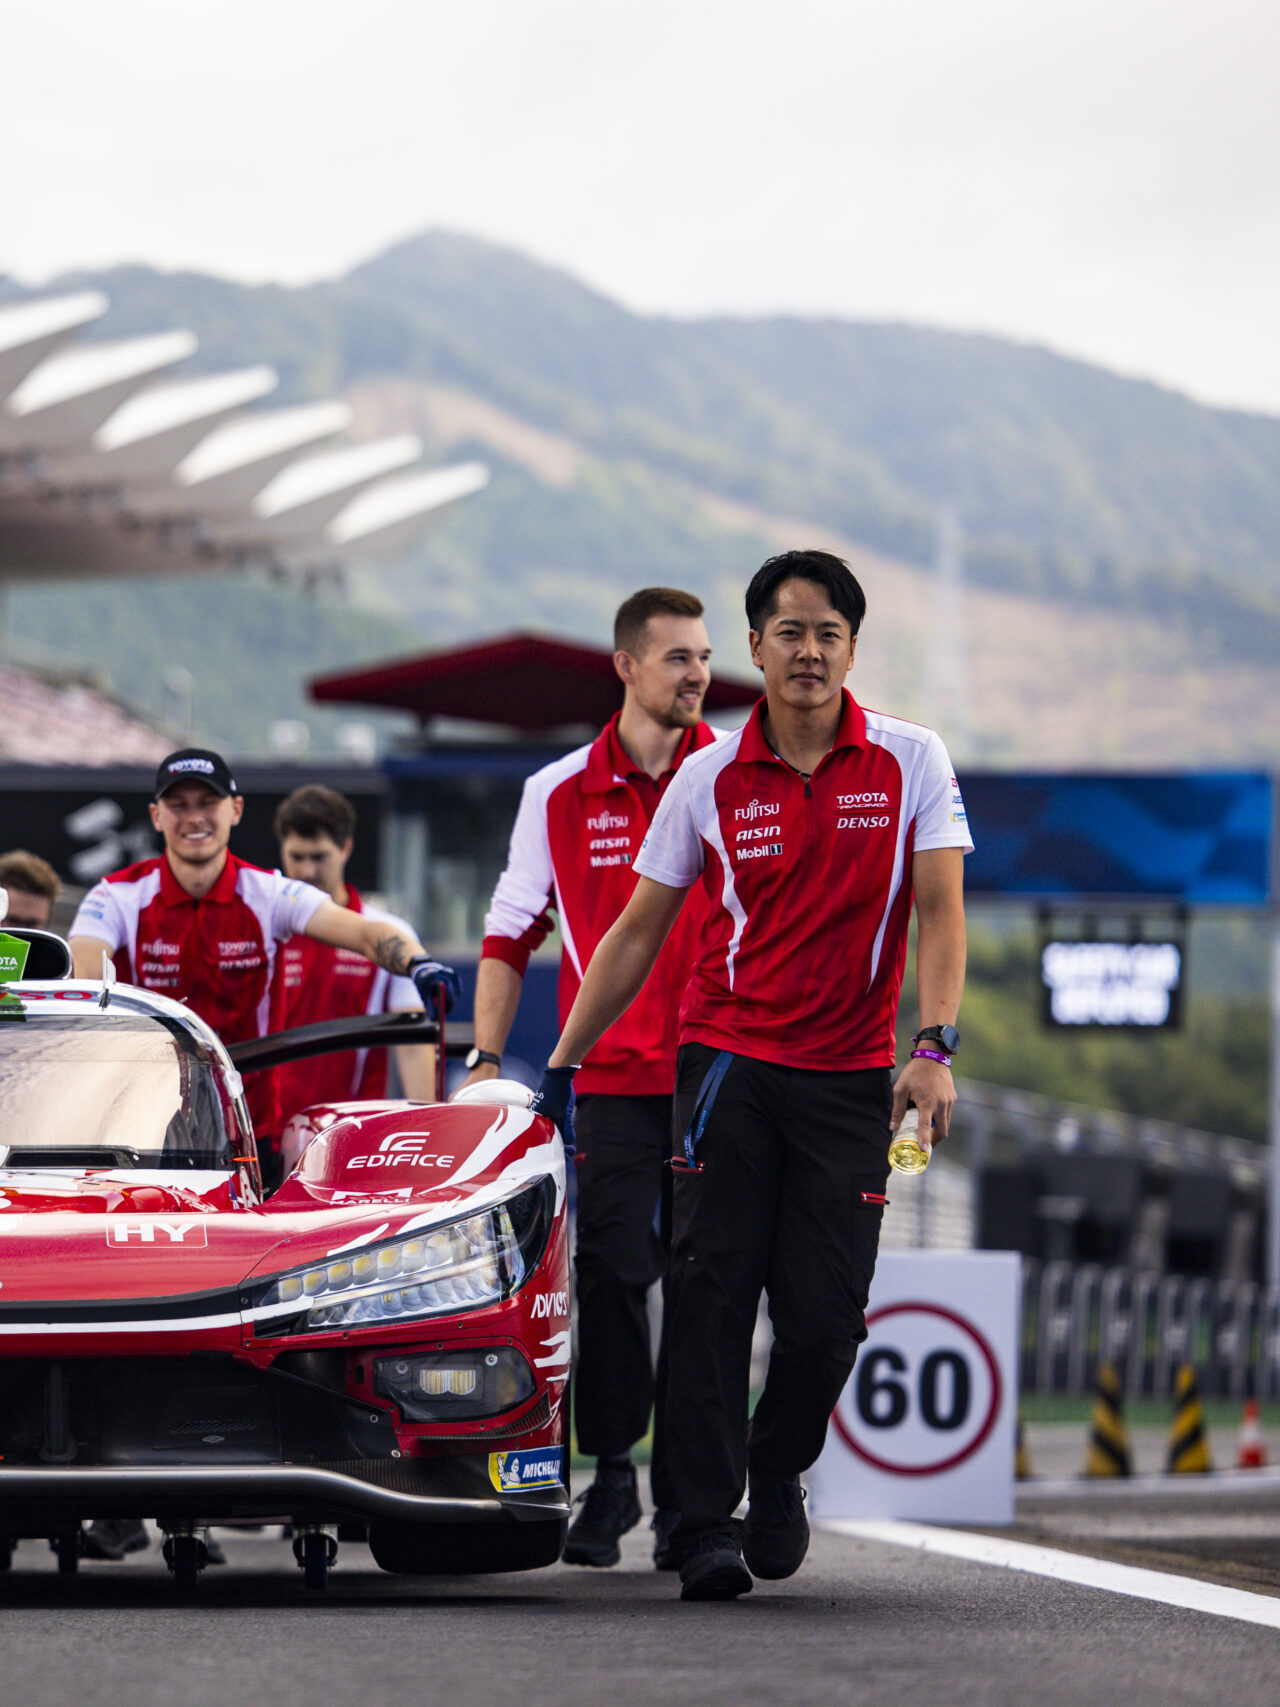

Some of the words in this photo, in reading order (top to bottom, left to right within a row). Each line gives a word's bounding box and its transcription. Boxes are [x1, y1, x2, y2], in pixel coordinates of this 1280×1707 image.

[836, 792, 889, 805] TOYOTA
[734, 799, 780, 822] FUJITSU
[587, 810, 629, 832] FUJITSU
[837, 816, 890, 829] DENSO
[735, 825, 781, 842] AISIN
[589, 836, 630, 850] AISIN
[590, 855, 621, 868] Mobil
[736, 845, 769, 861] Mobil
[142, 937, 179, 957] FUJITSU
[346, 1153, 455, 1169] EDIFICE
[114, 1223, 197, 1242] HY
[530, 1291, 568, 1319] ADVICS
[856, 1348, 970, 1430] 60
[522, 1460, 561, 1479] MICHELIN
